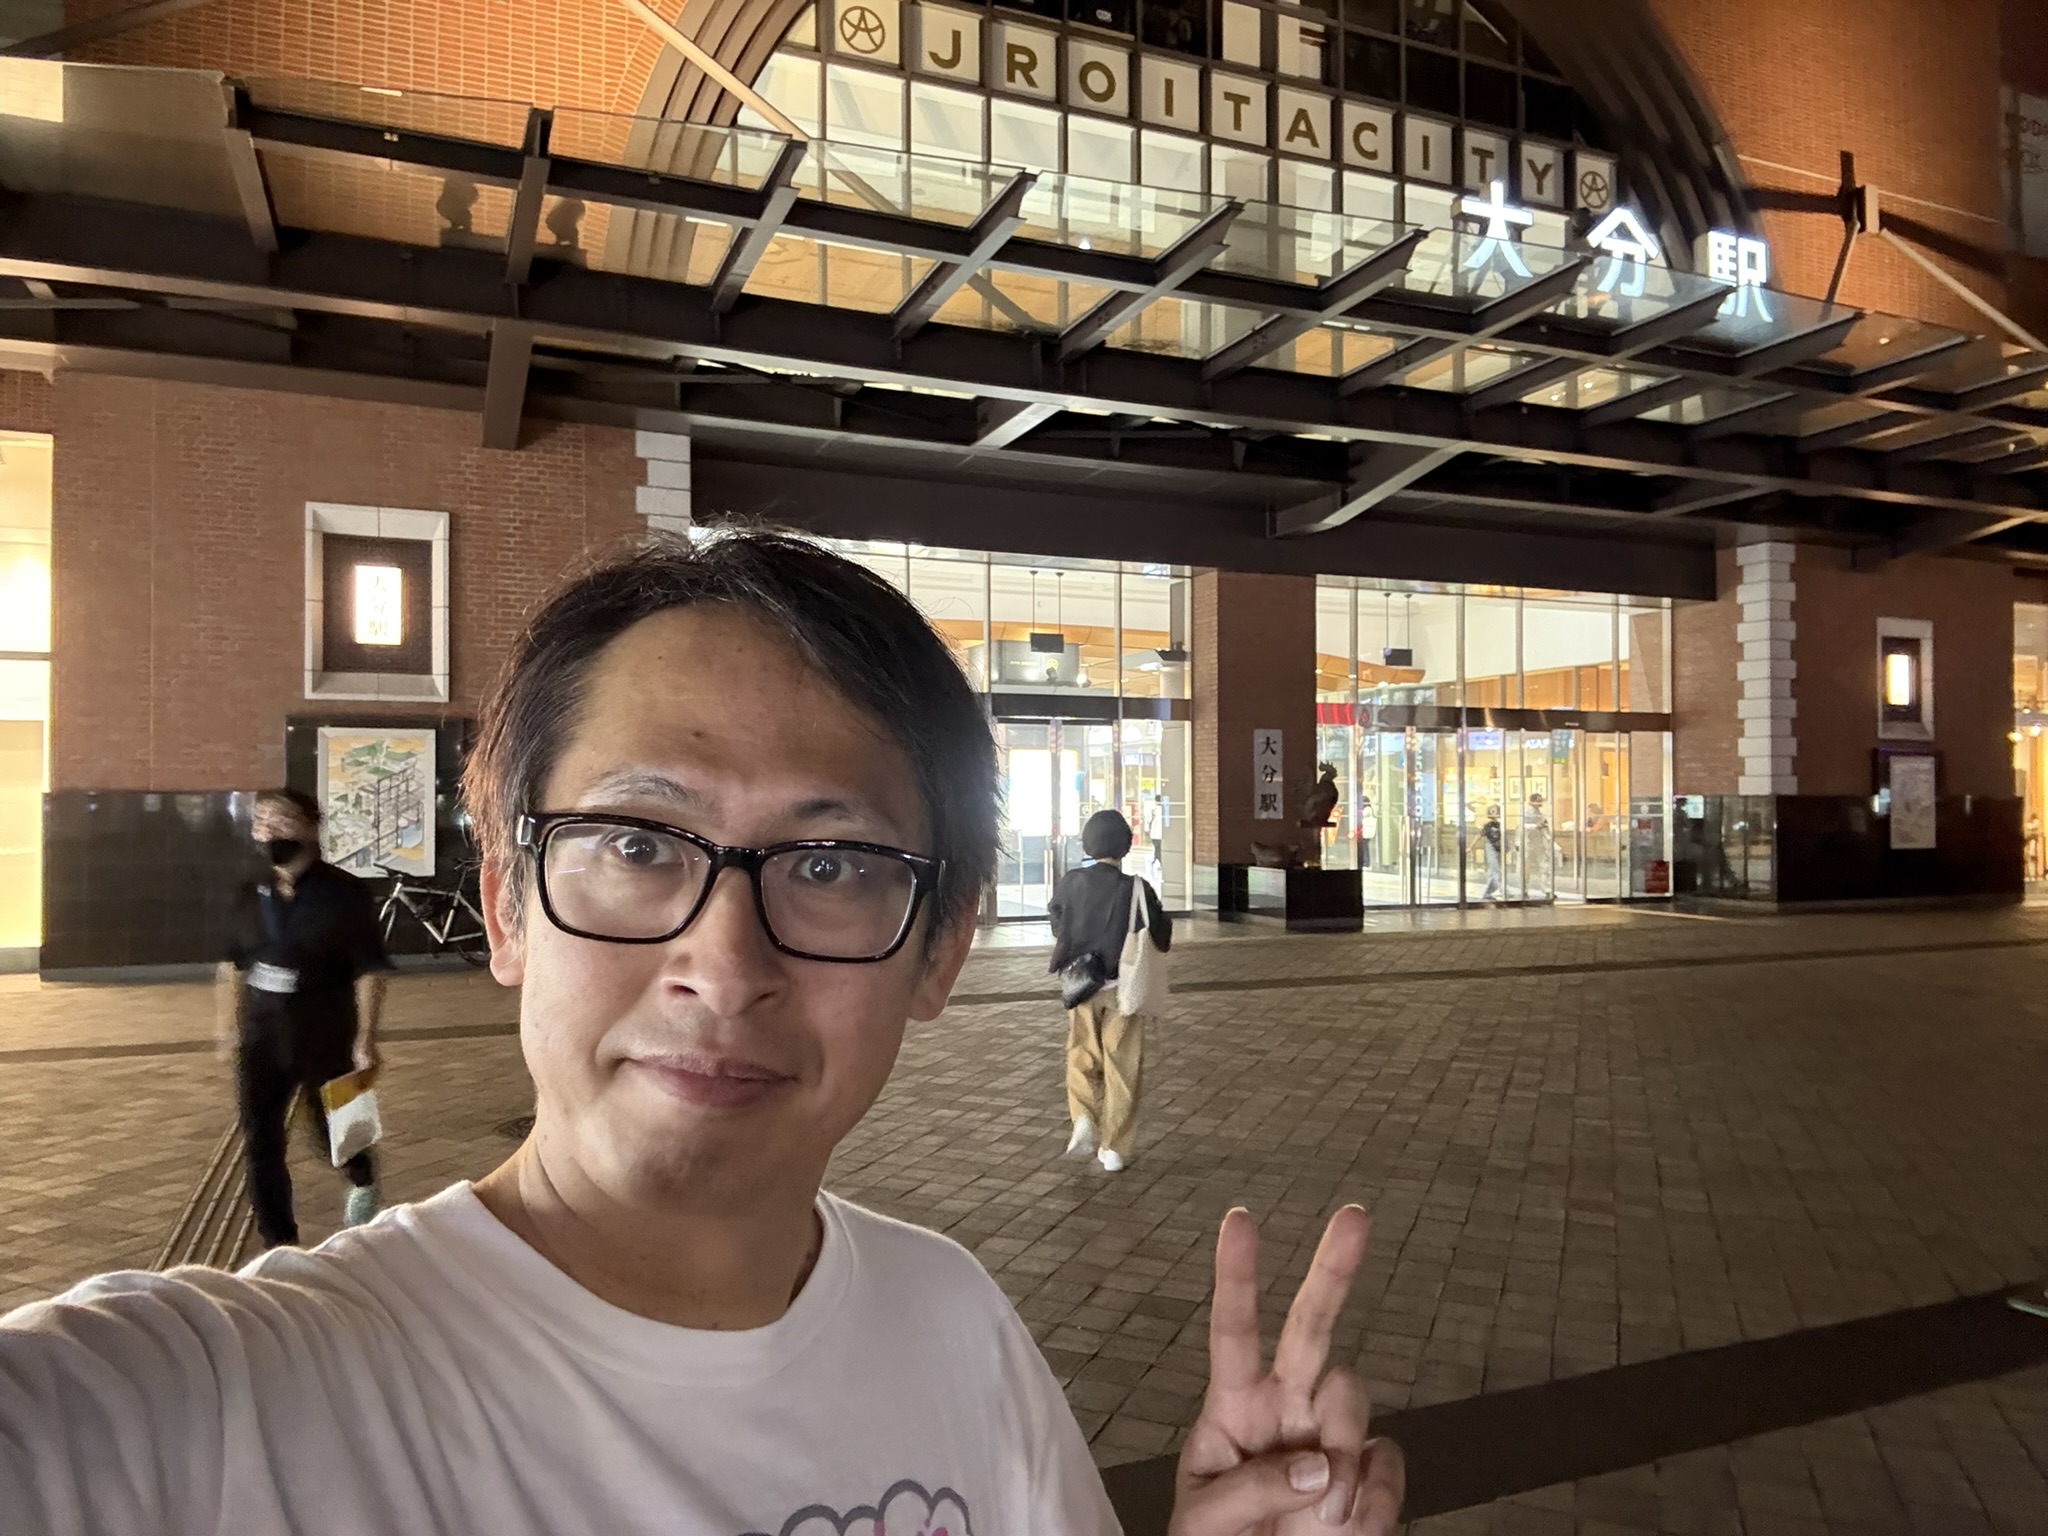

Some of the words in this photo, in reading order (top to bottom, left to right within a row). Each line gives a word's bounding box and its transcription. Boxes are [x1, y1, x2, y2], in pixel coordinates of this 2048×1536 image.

[1459, 180, 1774, 323] 大分駅
[1259, 735, 1278, 813] 大分駅
